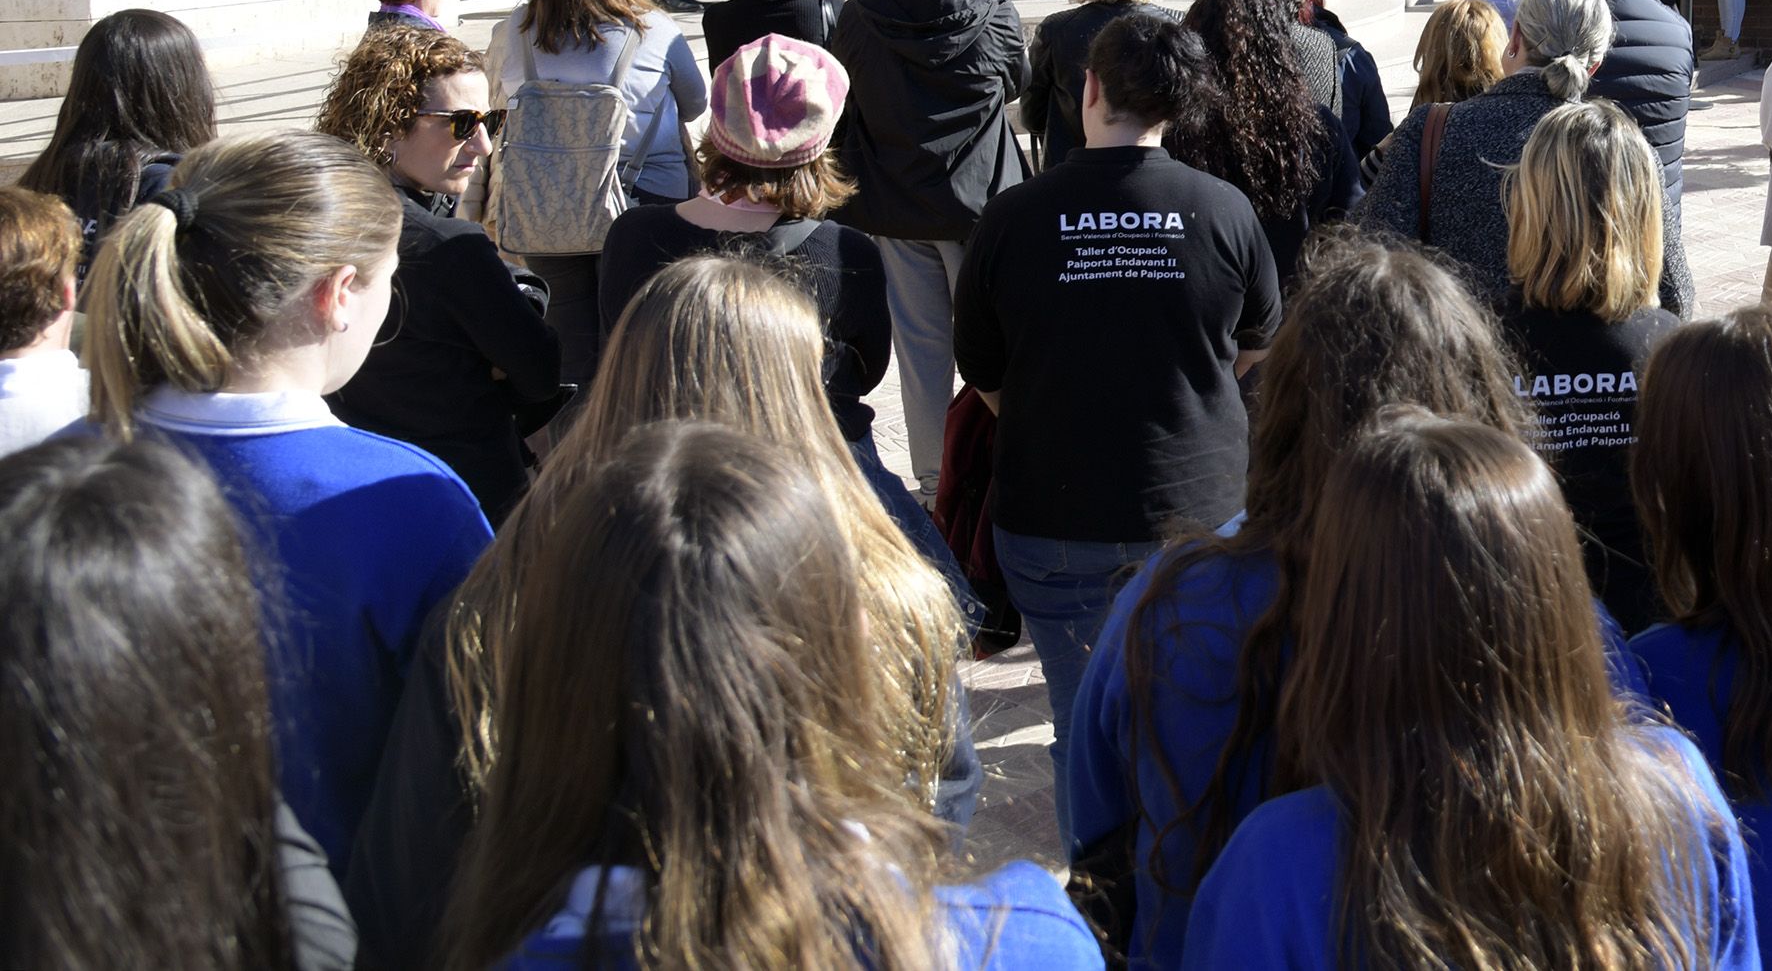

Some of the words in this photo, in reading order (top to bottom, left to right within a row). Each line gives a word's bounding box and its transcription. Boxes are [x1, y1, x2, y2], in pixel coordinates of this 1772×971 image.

[1060, 212, 1184, 232] LABORA
[1076, 247, 1105, 256] Taller
[1107, 246, 1168, 256] d'Ocupació
[1067, 260, 1113, 269] Paiporta
[1115, 258, 1165, 267] Endavant
[1167, 258, 1177, 267] II
[1059, 270, 1123, 283] Ajuntament
[1125, 269, 1139, 278] de
[1140, 269, 1185, 280] Paiporta
[1514, 371, 1638, 396] LABORA
[1560, 411, 1621, 423] d'Ocupació
[1566, 425, 1618, 436] Endavant
[1620, 423, 1630, 432] II
[1575, 438, 1590, 447] de
[1591, 436, 1639, 446] Paiporta
